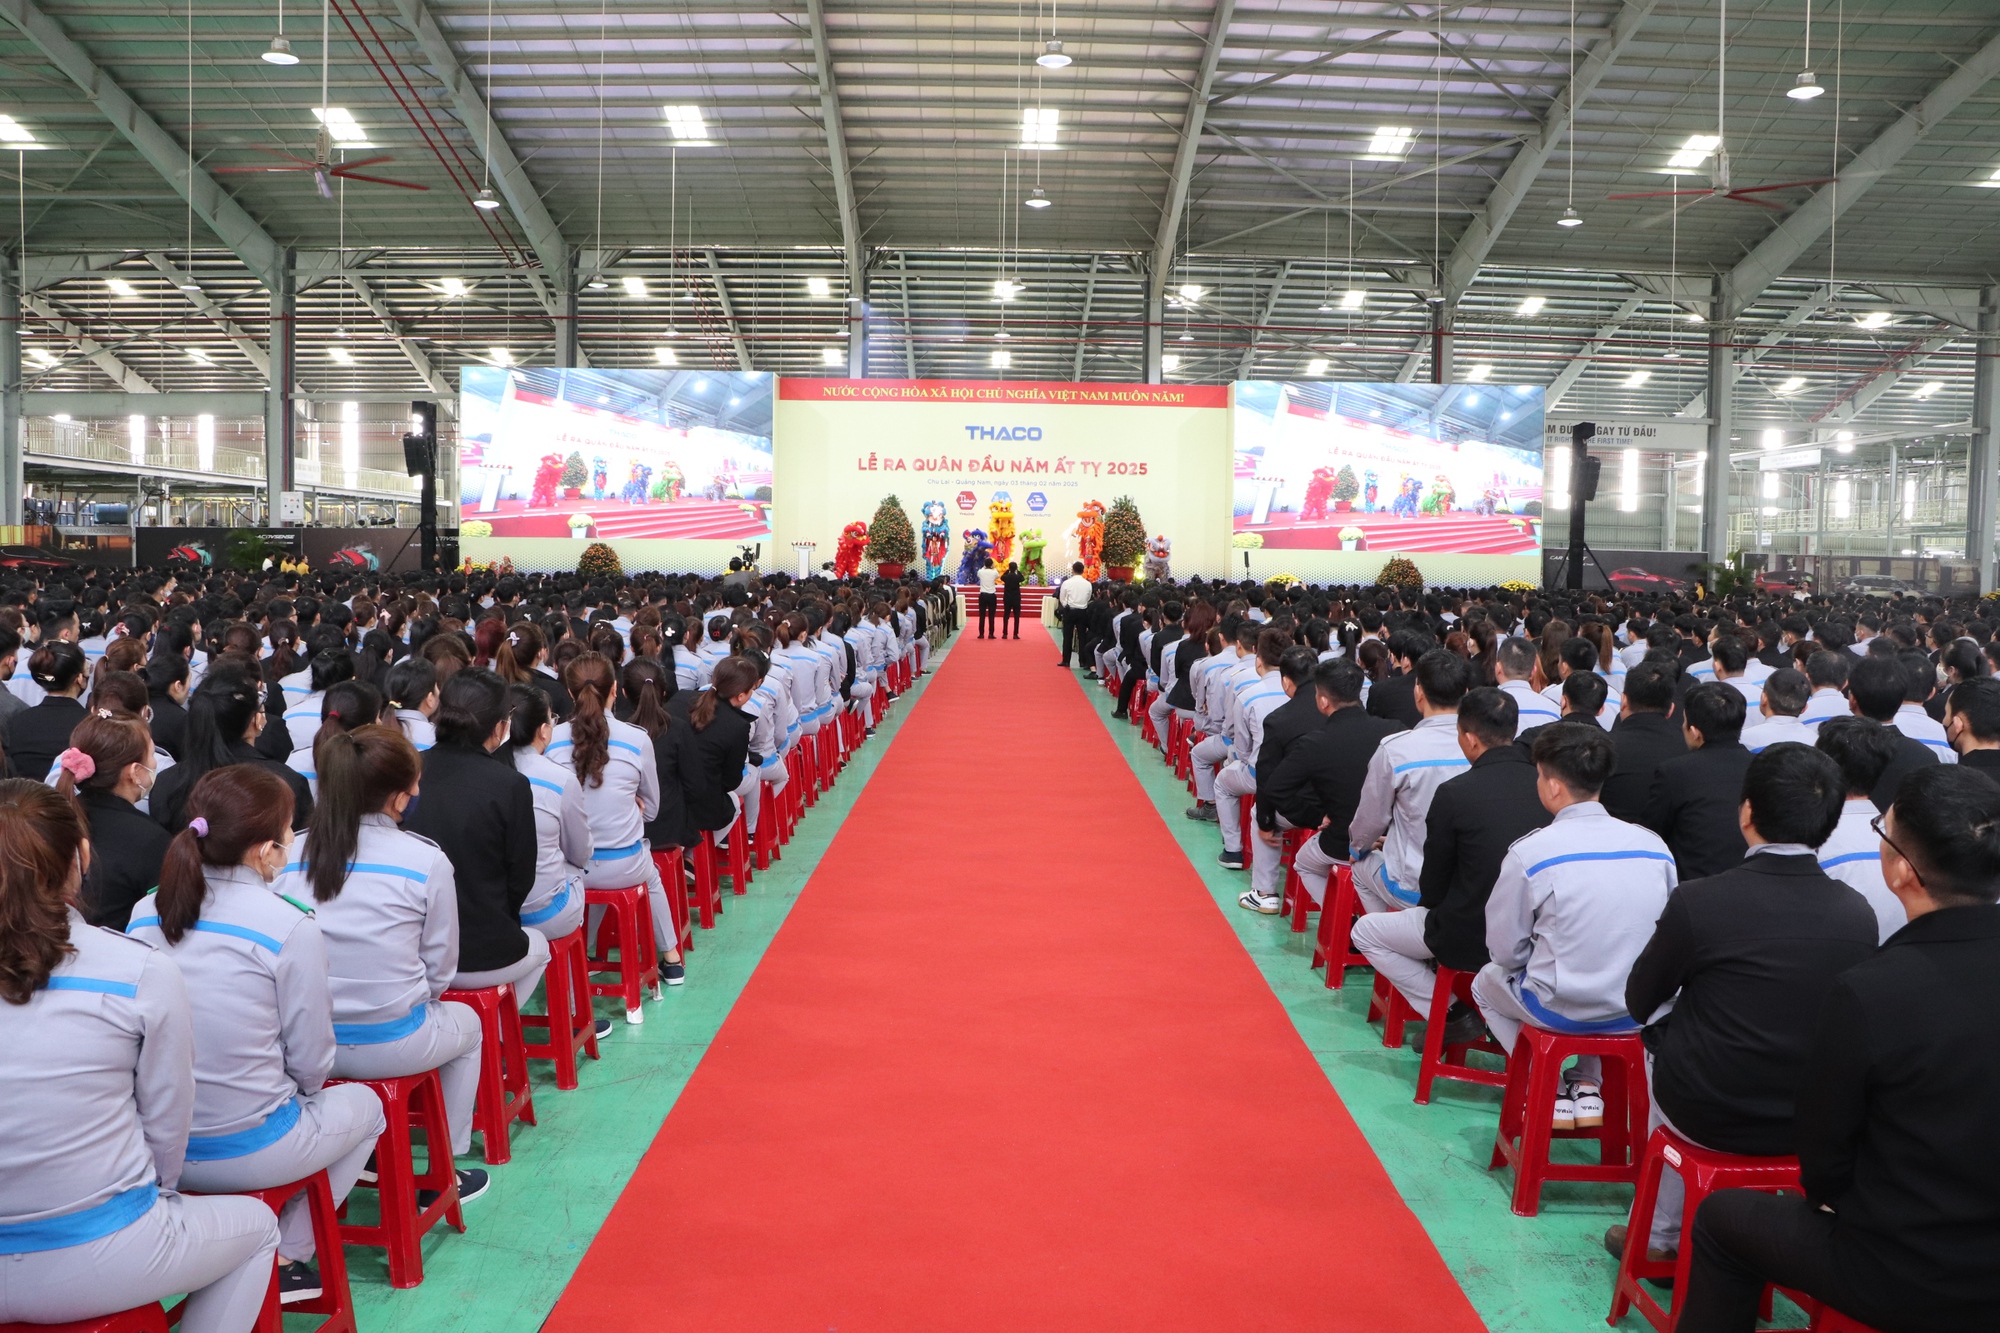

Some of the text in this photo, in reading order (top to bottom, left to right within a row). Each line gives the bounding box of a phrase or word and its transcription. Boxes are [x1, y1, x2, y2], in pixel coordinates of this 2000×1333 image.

[822, 385, 1184, 403] NƯỚC CỘNG HÒA XÃ HỘI CHỦ NGHĨA VIỆT NAM MUÔN NĂM!
[965, 426, 1042, 441] THACO
[1596, 426, 1615, 436] GAY
[1618, 424, 1631, 437] TỪ
[1633, 424, 1656, 437] ĐẦU!
[858, 452, 1148, 477] LỄ RA QUÂN ĐẦU NĂM ẤT TỴ 2025
